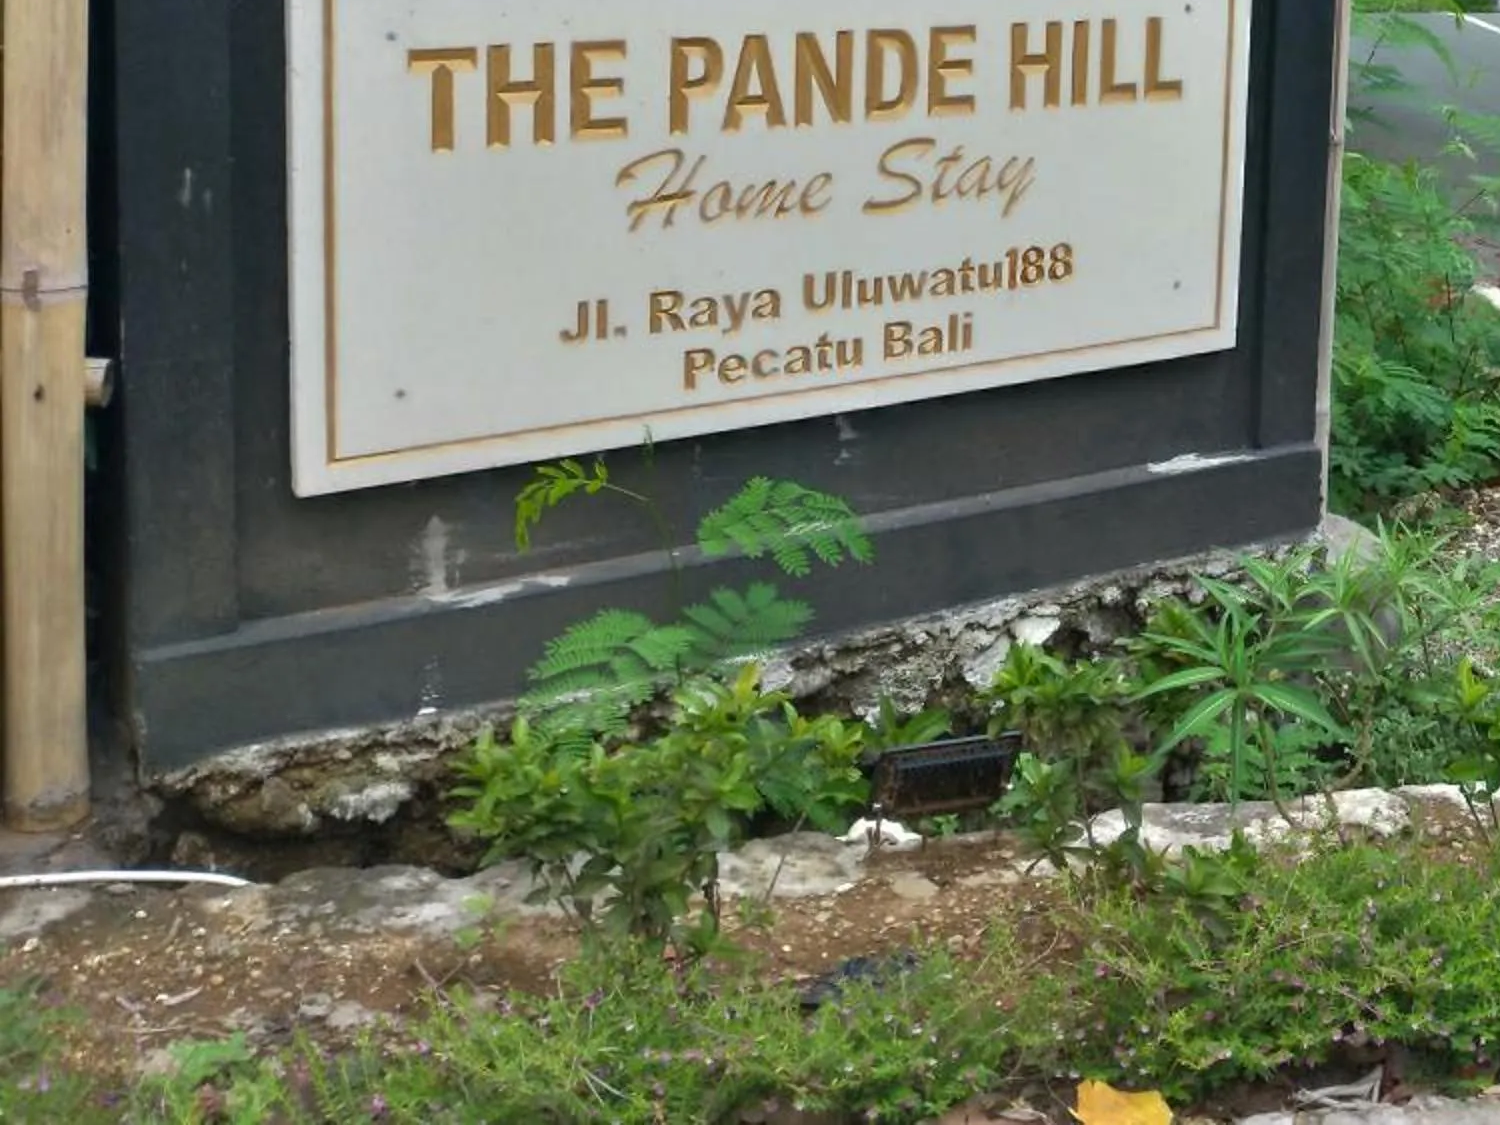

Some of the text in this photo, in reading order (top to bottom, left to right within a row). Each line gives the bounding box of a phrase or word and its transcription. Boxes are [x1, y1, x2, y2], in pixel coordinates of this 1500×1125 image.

[408, 16, 1185, 154] THE PANDE HILL
[615, 137, 1038, 233] Home Stay
[648, 286, 783, 341] Raya
[682, 313, 976, 392] Pecatu Bali
